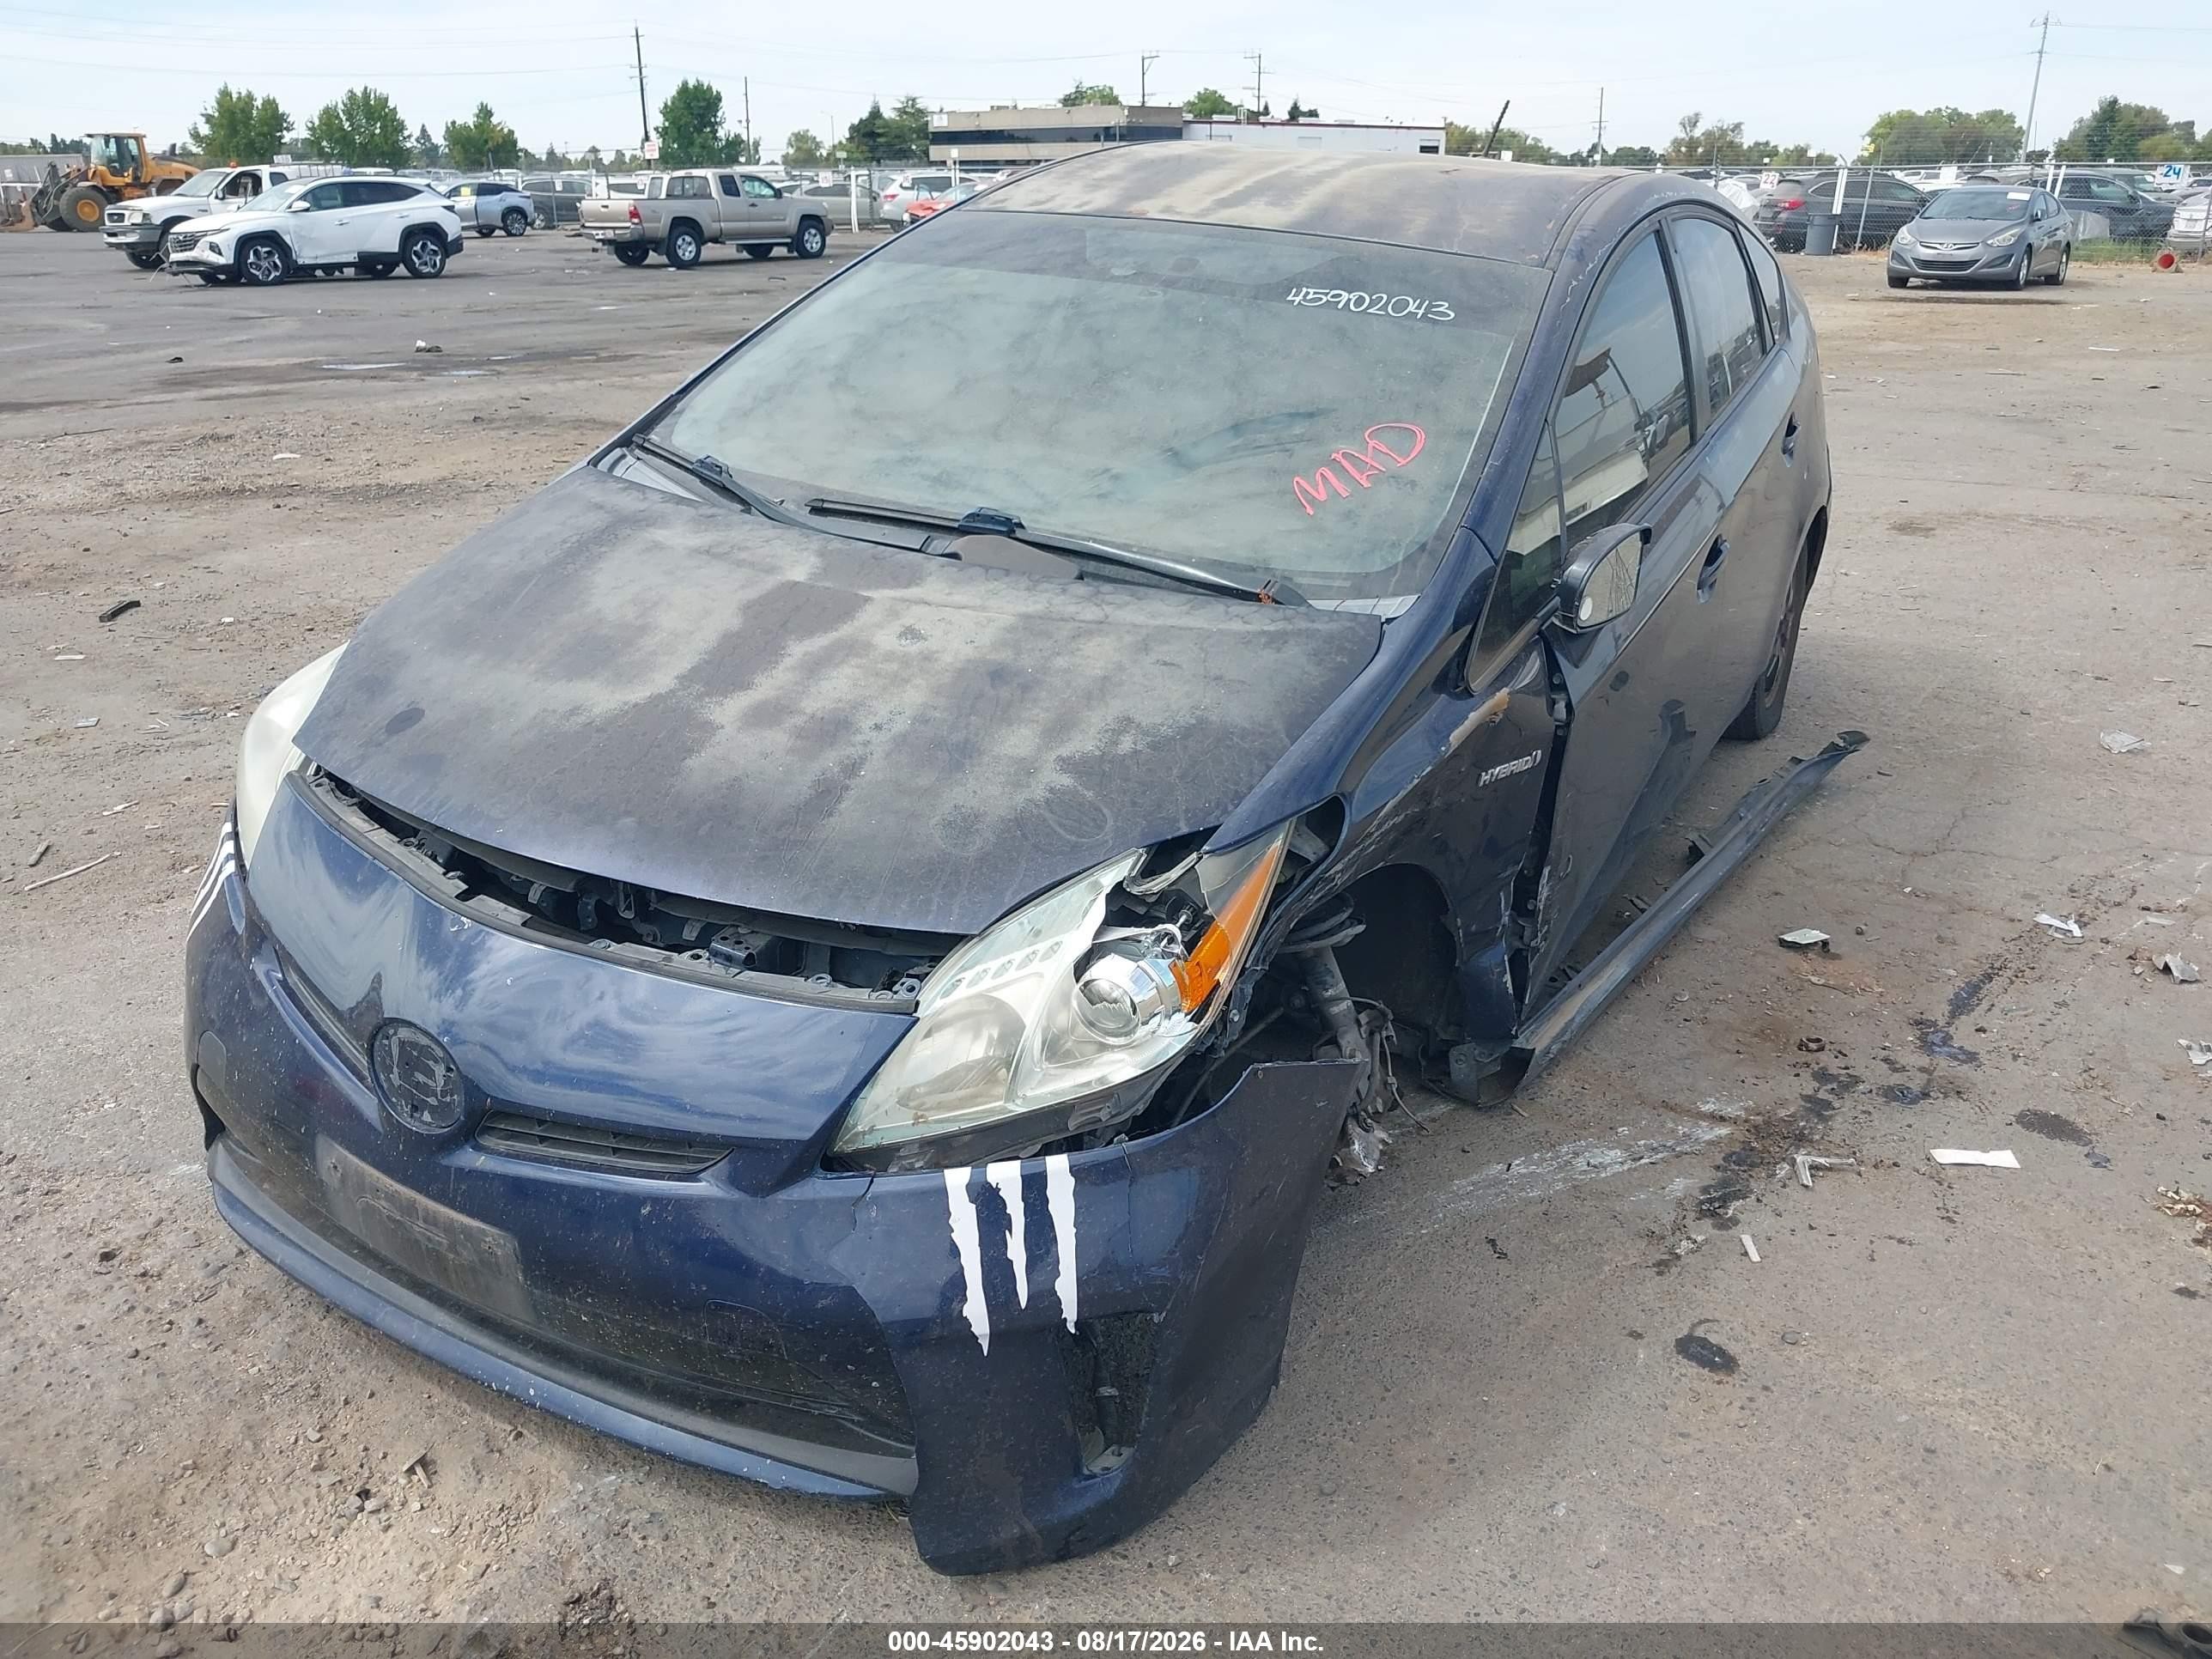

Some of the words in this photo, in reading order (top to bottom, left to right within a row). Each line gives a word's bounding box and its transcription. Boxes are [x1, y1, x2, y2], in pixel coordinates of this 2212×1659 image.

[2163, 165, 2182, 180] 24
[1285, 287, 1455, 321] 45902043
[1293, 422, 1426, 515] MAD
[1479, 756, 1534, 787] HYBRID
